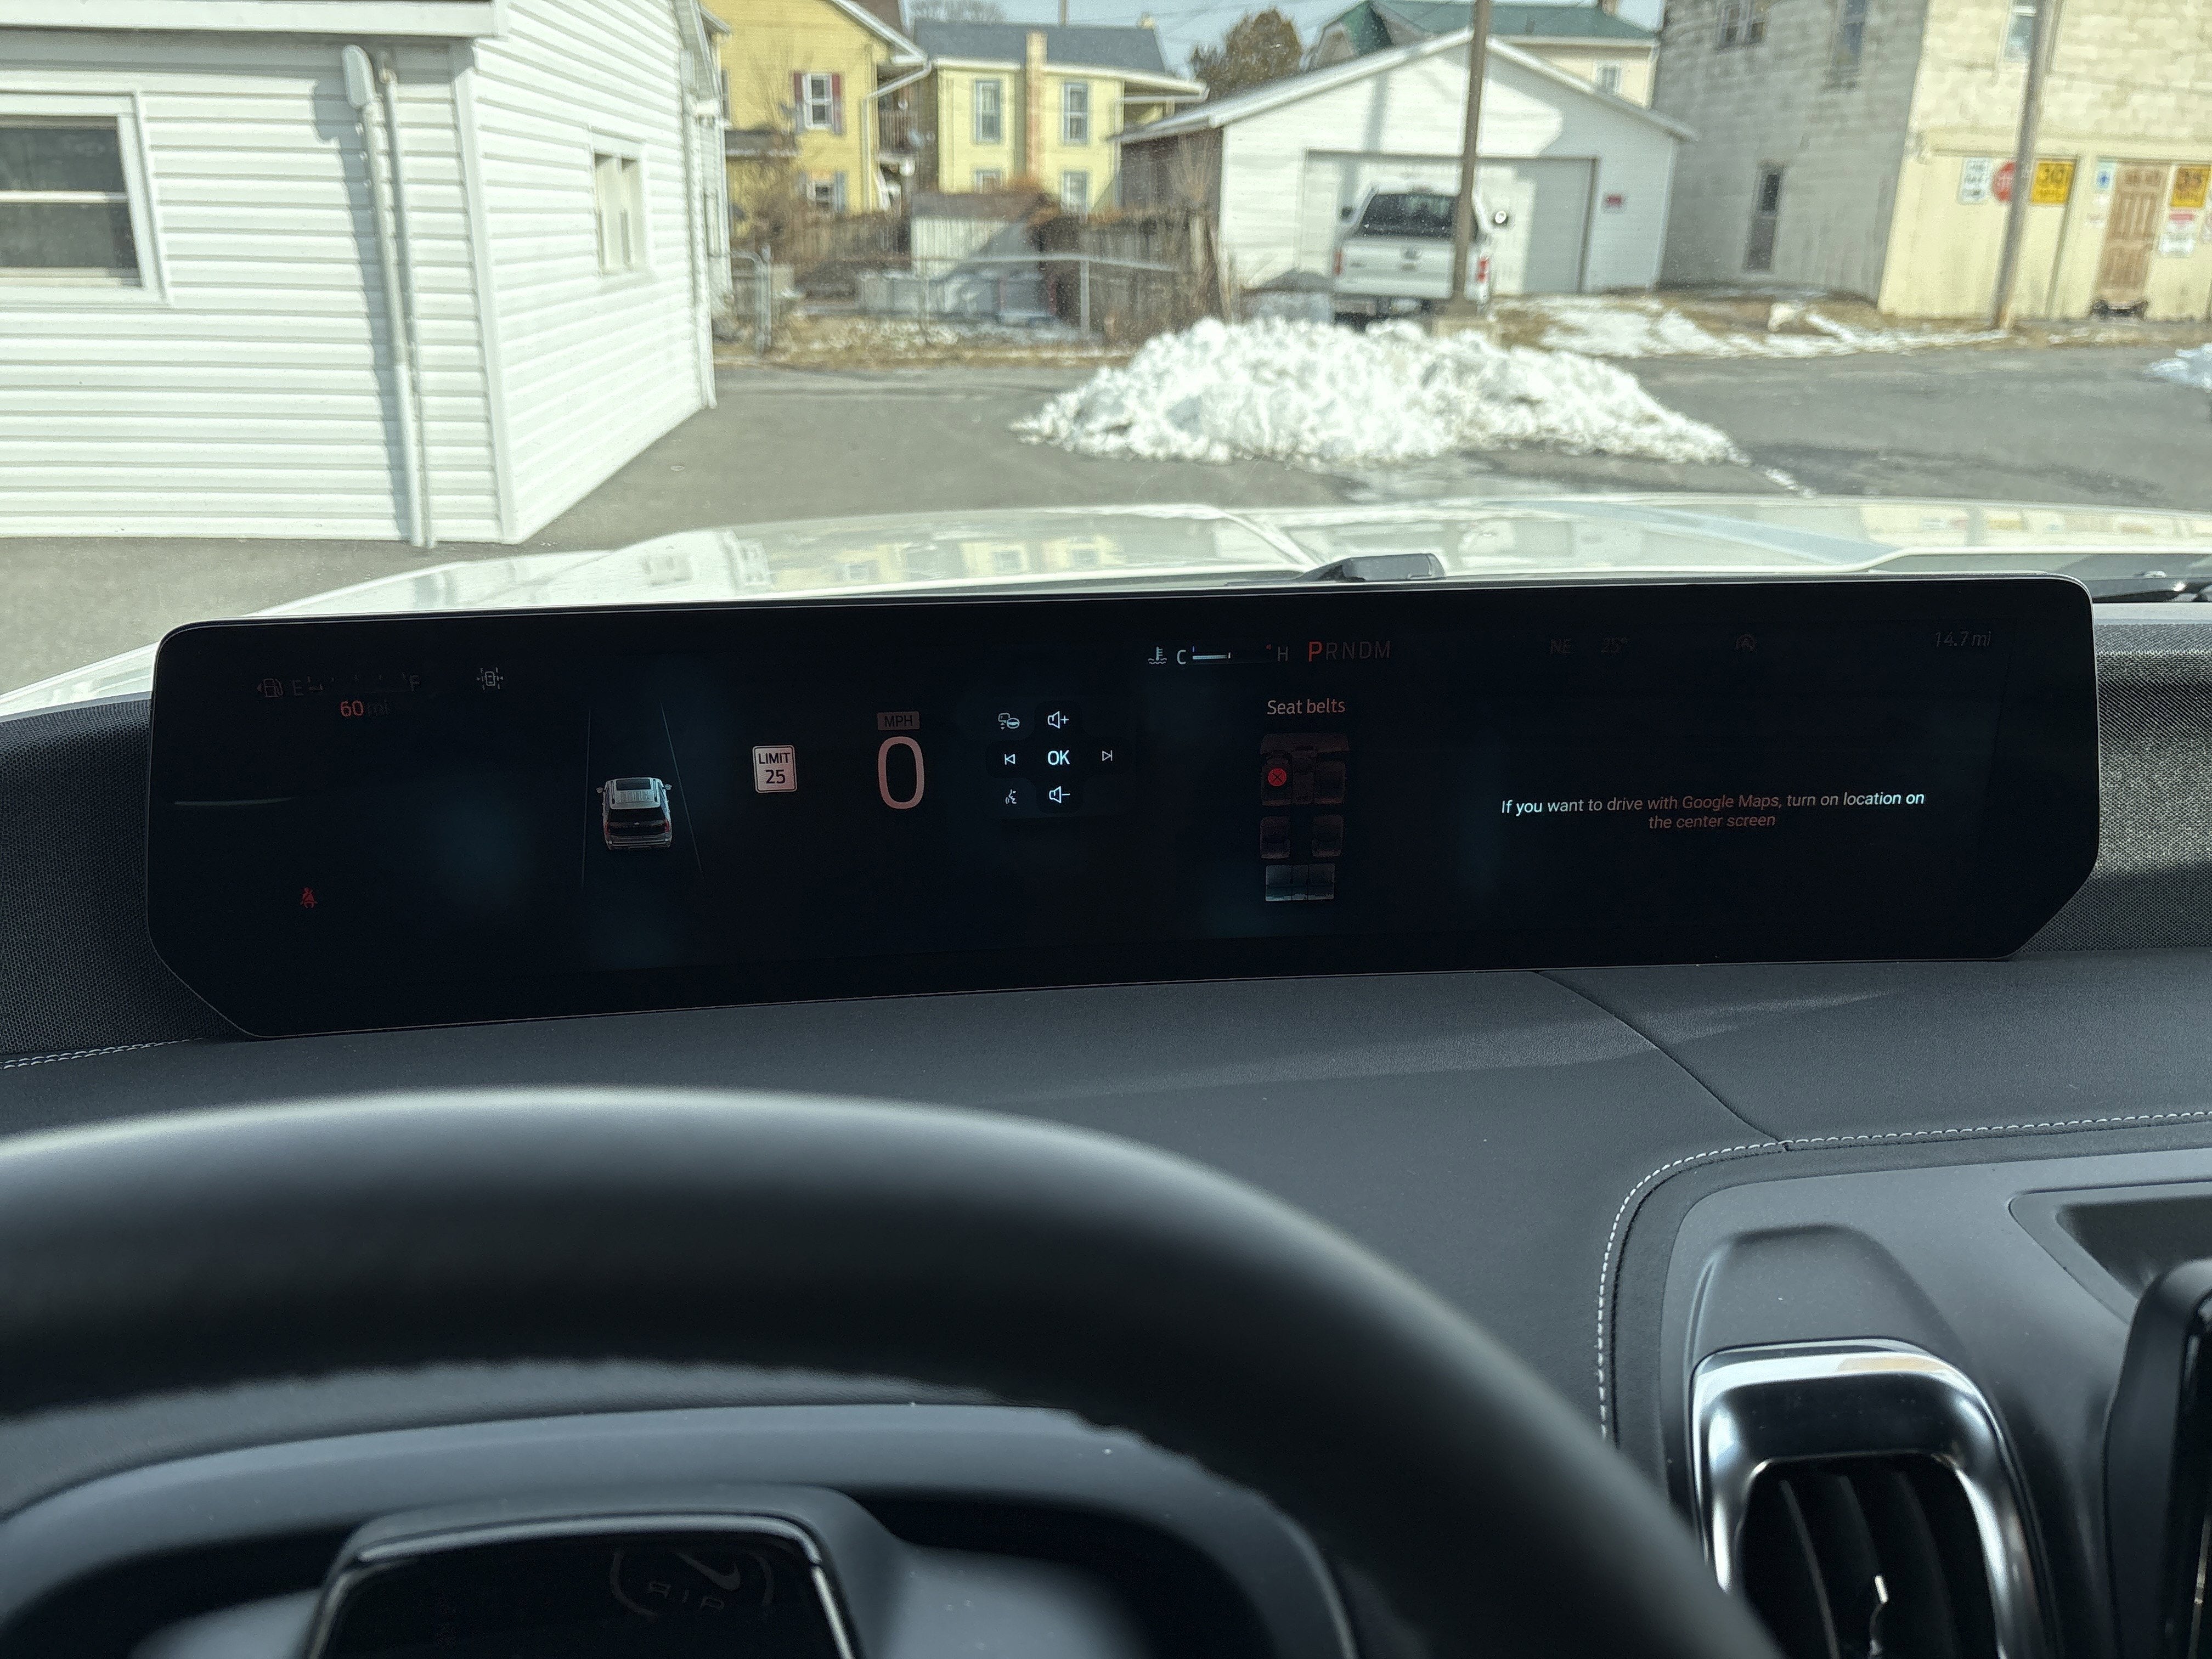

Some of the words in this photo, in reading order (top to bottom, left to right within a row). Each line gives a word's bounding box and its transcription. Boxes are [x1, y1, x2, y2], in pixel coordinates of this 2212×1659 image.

[1277, 646, 1289, 662] H
[1550, 638, 1572, 654] NE
[1176, 649, 1187, 665] C
[340, 700, 364, 716] 60
[1267, 699, 1302, 715] Seat
[1306, 697, 1346, 714] belts
[884, 715, 913, 727] MPH
[759, 753, 790, 764] LIMIT
[1047, 749, 1070, 766] OK
[766, 770, 786, 783] 25
[878, 736, 924, 809] 0
[1501, 799, 1513, 814] If
[1515, 803, 1543, 816] you
[1547, 799, 1584, 812] want
[1588, 798, 1603, 811] to
[1607, 797, 1643, 811] drive
[1647, 795, 1678, 810] with
[1681, 794, 1734, 812] Google
[1738, 794, 1782, 810] Maps,
[1786, 794, 1816, 806] turn
[1820, 795, 1839, 806] on
[1843, 791, 1901, 805] location
[1905, 793, 1925, 805] on
[1649, 815, 1672, 829] the
[1676, 816, 1723, 828] center
[1726, 815, 1776, 827] screen
